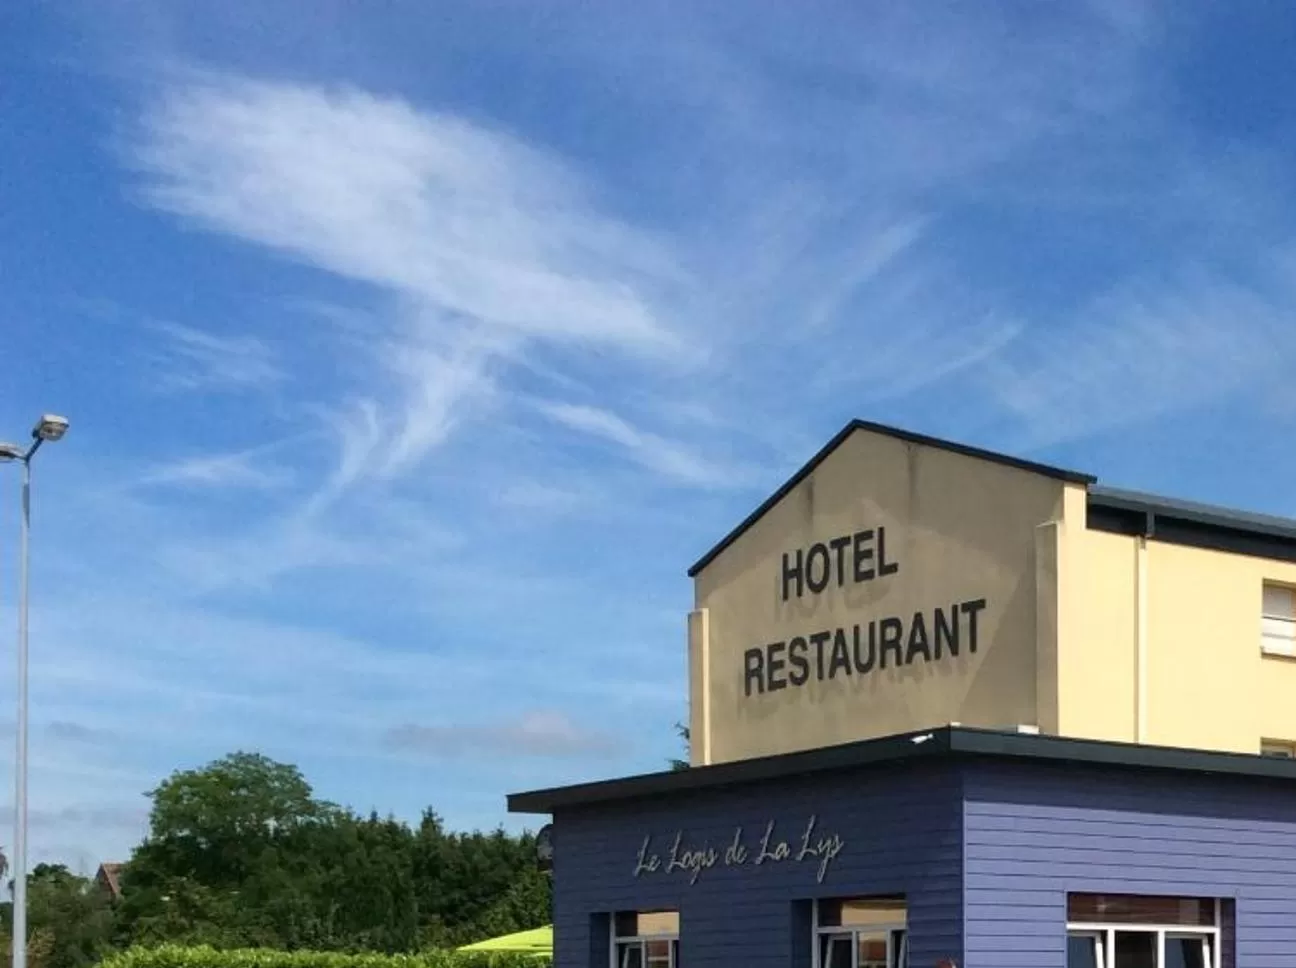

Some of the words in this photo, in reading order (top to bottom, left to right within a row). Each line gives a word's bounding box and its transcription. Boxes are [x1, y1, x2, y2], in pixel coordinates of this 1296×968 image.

[782, 527, 898, 601] HOTEL
[744, 598, 985, 696] RESTAURANT
[634, 835, 662, 877] Le
[666, 829, 718, 886] Logis
[725, 827, 748, 865] de
[755, 820, 790, 865] La
[795, 814, 845, 883] Lys
